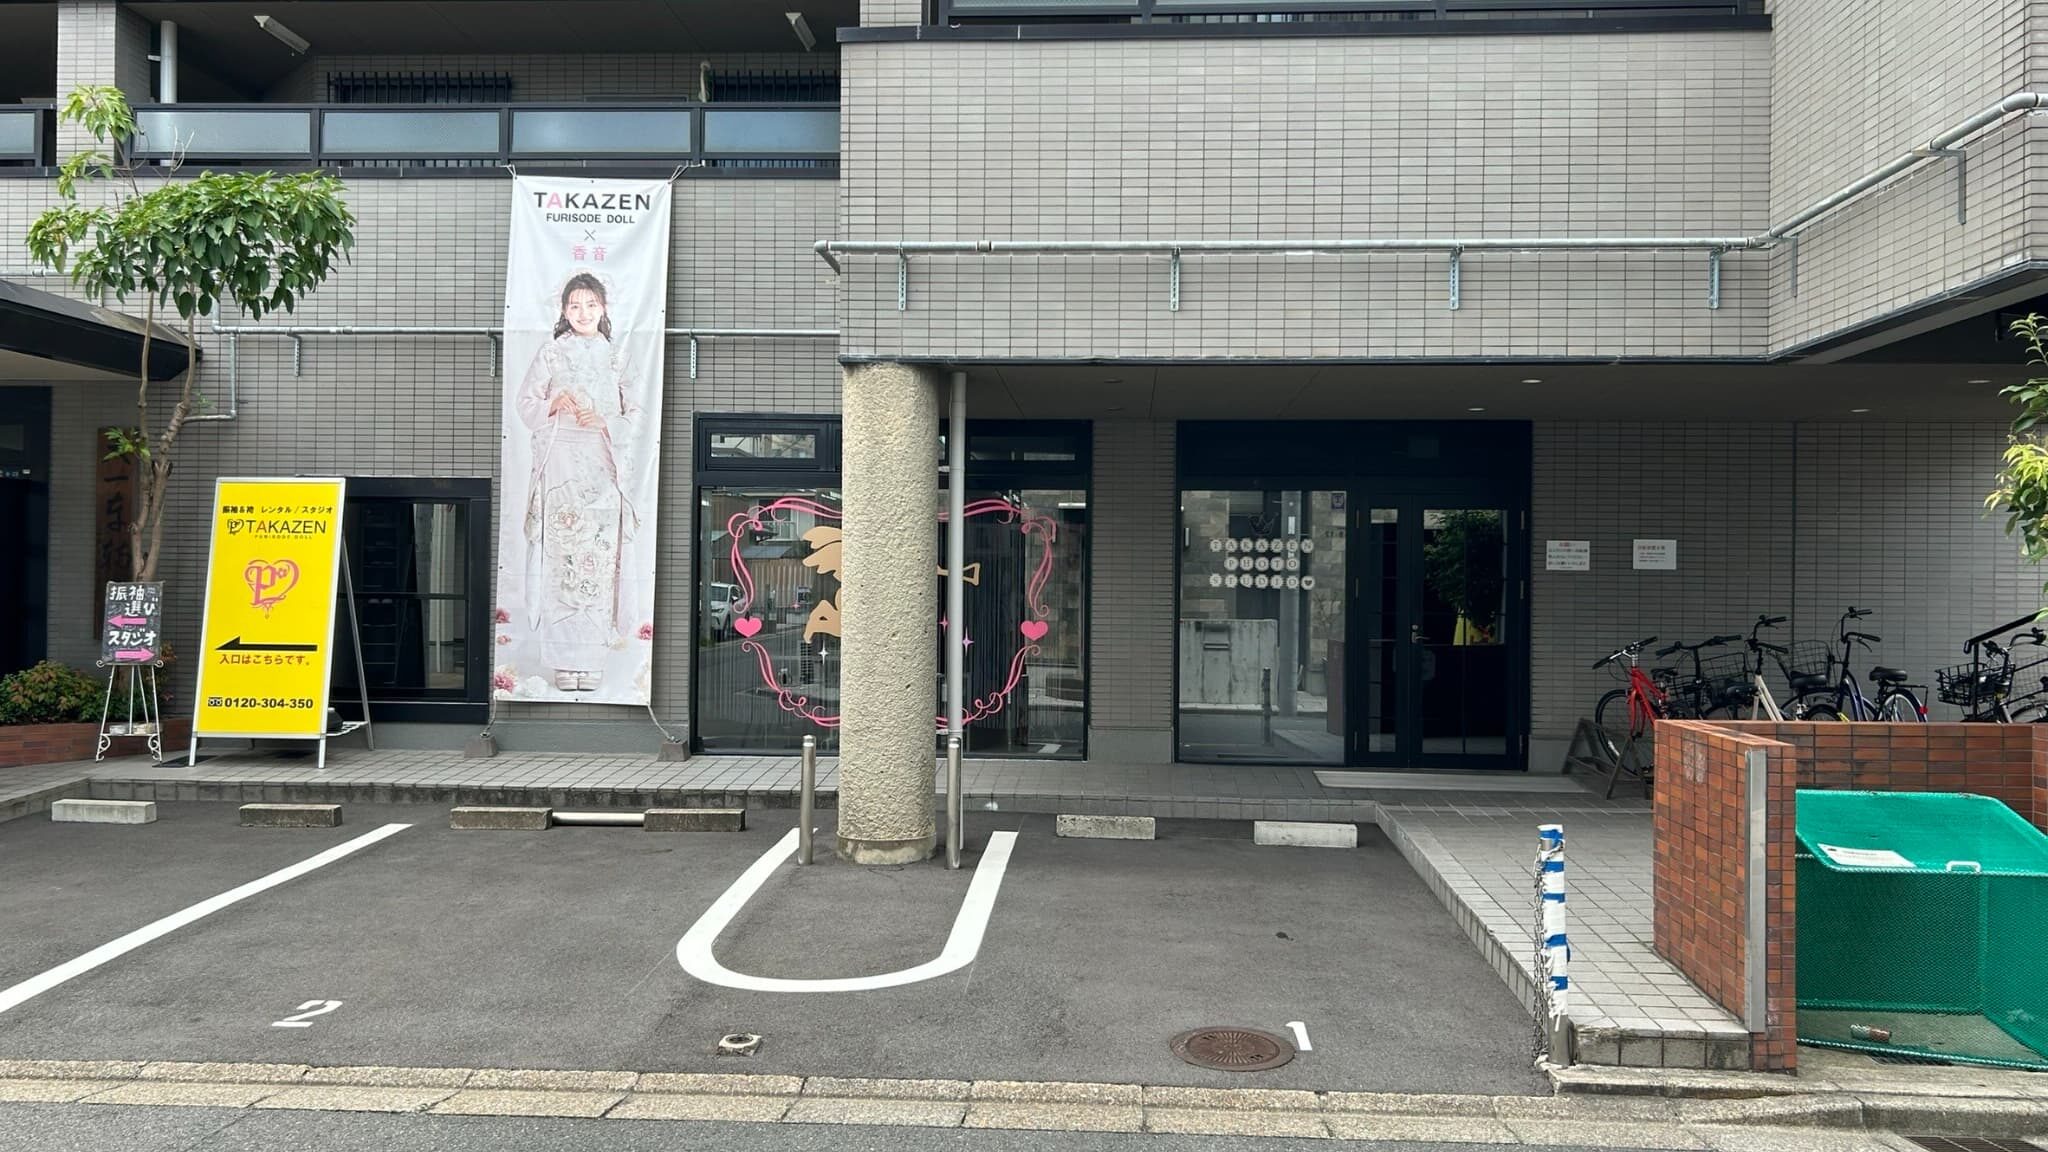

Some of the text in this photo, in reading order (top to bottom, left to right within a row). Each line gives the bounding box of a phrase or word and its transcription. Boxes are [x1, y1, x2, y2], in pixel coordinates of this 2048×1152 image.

[533, 192, 651, 210] TAKAZEN
[546, 213, 635, 224] FURISODE DOLL
[571, 245, 607, 262] 香音
[246, 520, 327, 534] TAKAZEN
[1211, 539, 1312, 552] TAKAZEN
[1226, 557, 1298, 571] PHOTO
[1211, 575, 1298, 588] STUDIO
[109, 585, 145, 601] 振袖
[124, 597, 159, 617] 選び
[108, 628, 157, 646] スタジオ
[219, 654, 310, 666] 入口はこちらです。
[224, 697, 313, 709] 0120-304-350
[271, 1000, 343, 1028] 2
[1285, 1021, 1313, 1051] 1
